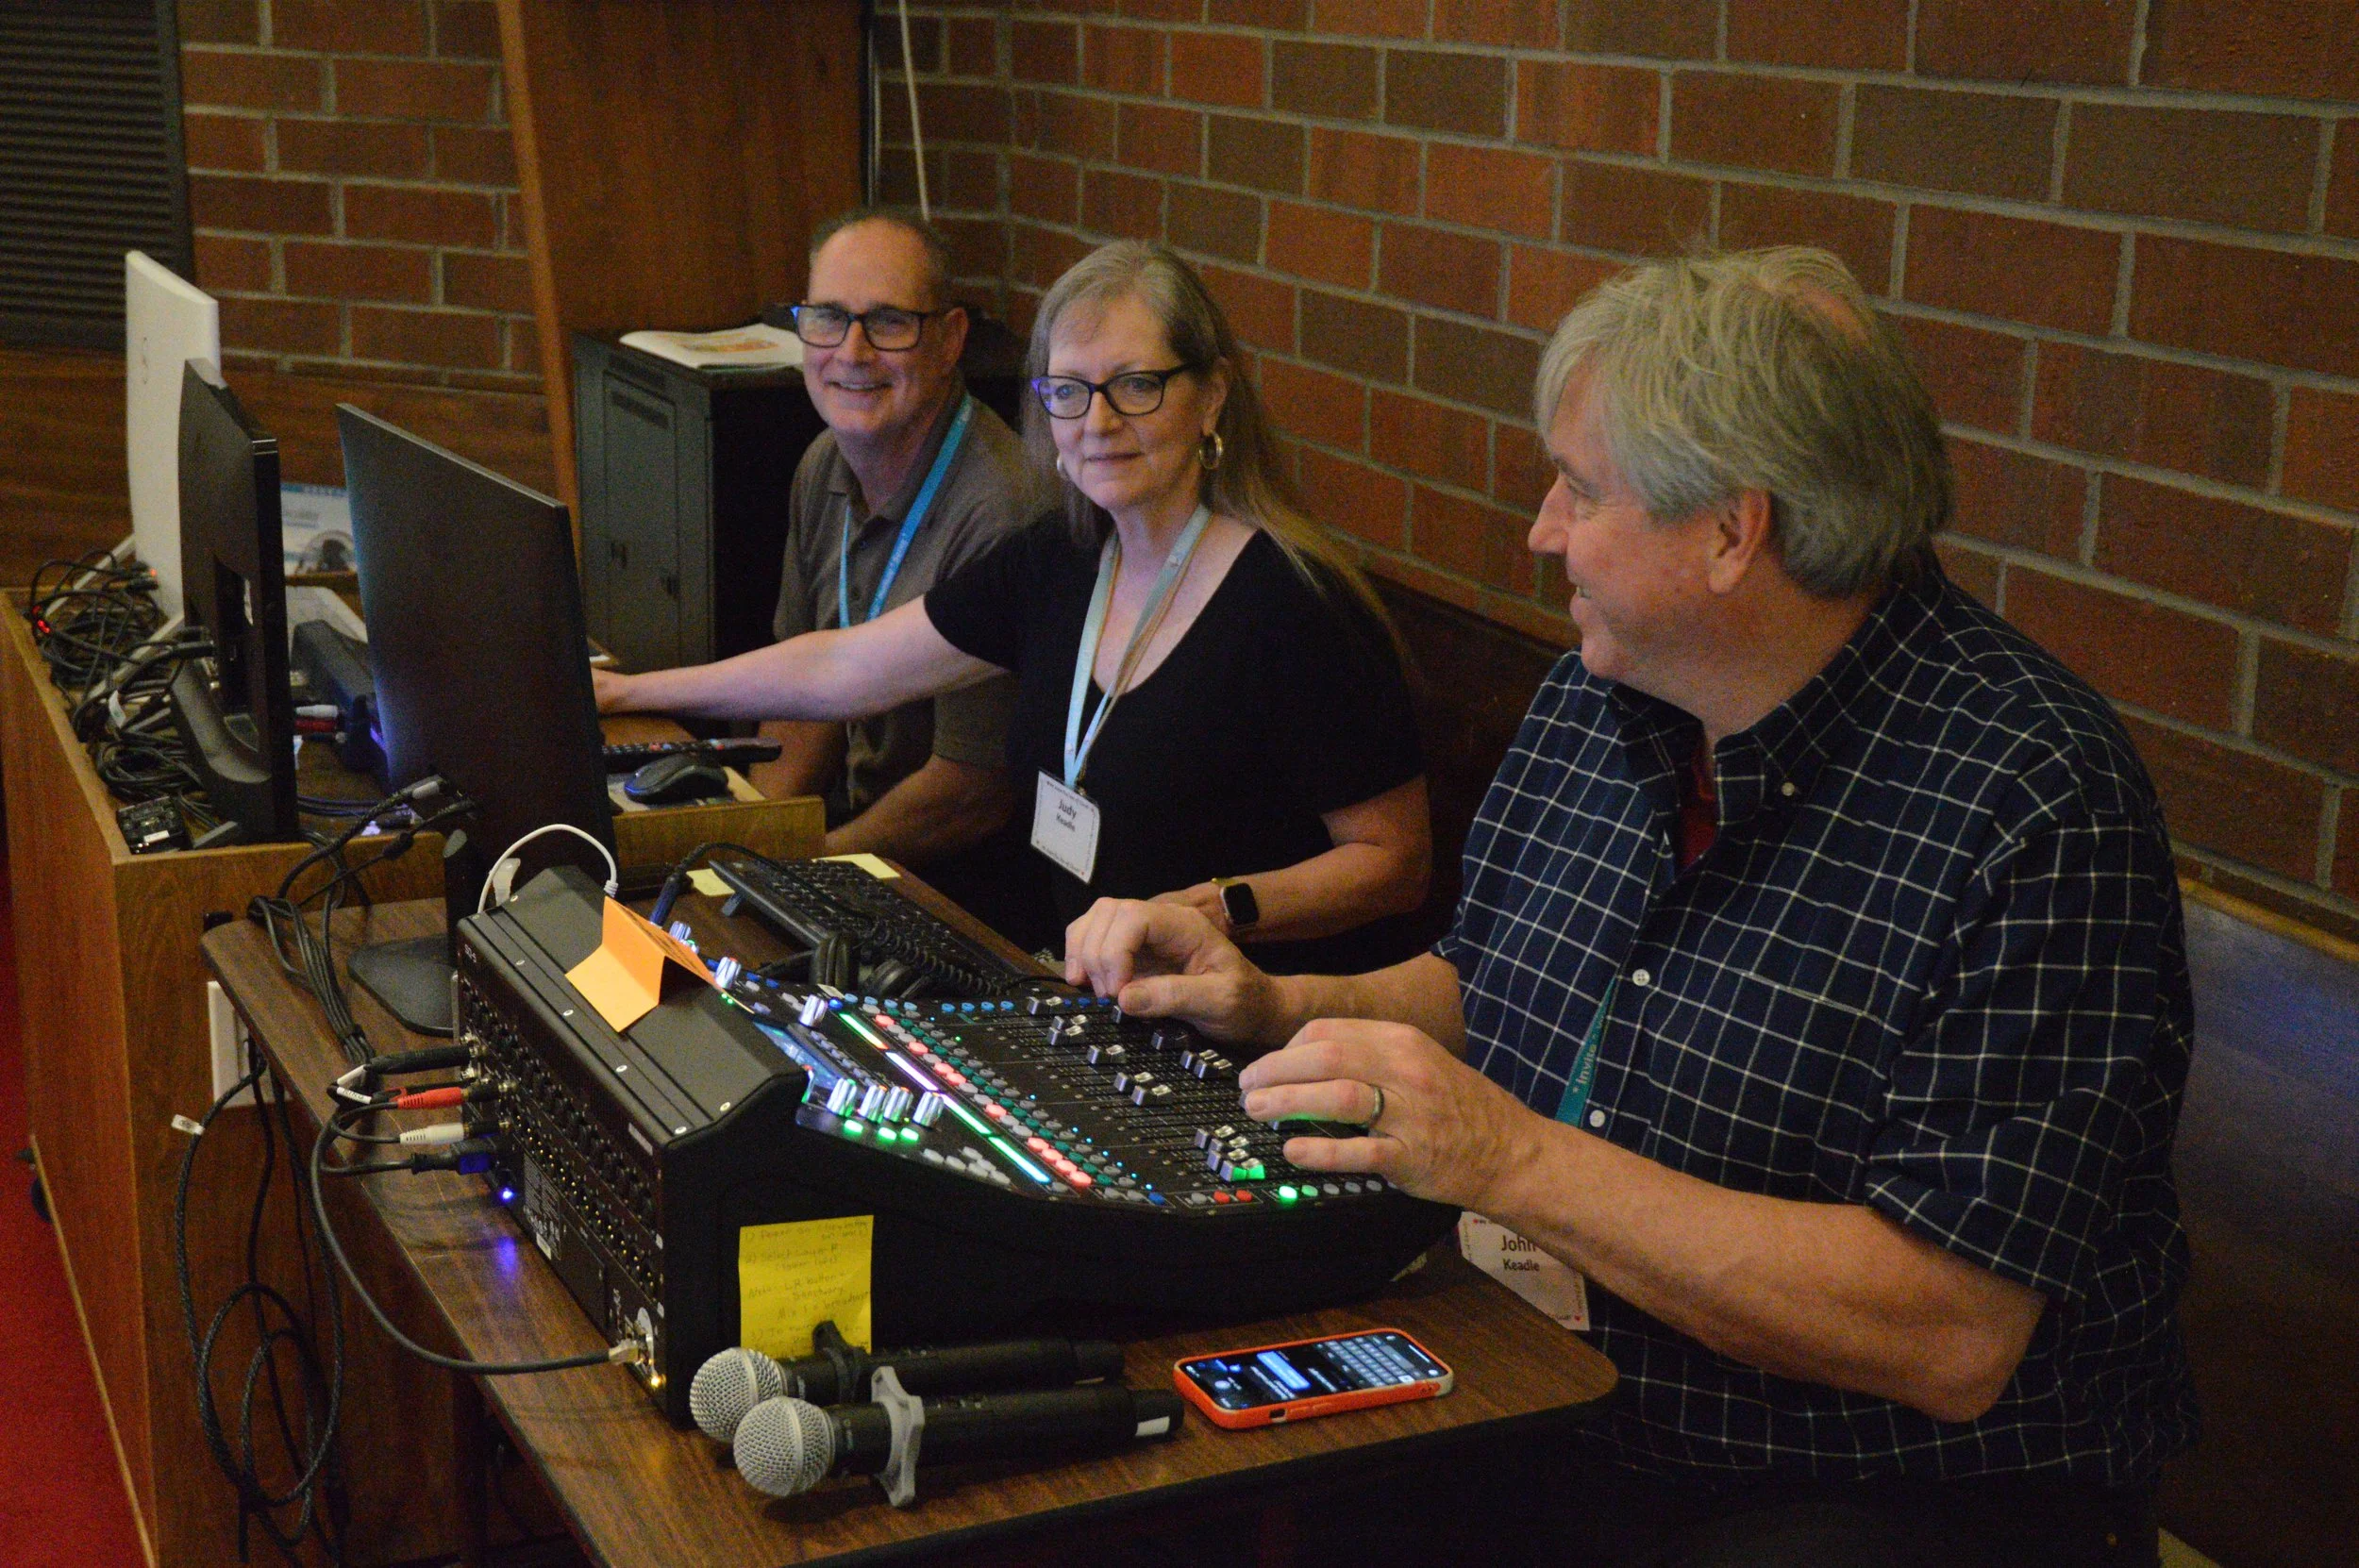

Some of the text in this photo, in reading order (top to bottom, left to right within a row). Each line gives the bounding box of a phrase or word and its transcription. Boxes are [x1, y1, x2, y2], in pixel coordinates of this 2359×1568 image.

[1059, 799, 1077, 819] Judy
[1501, 1235, 1536, 1253] John
[1502, 1258, 1540, 1273] Keadle
